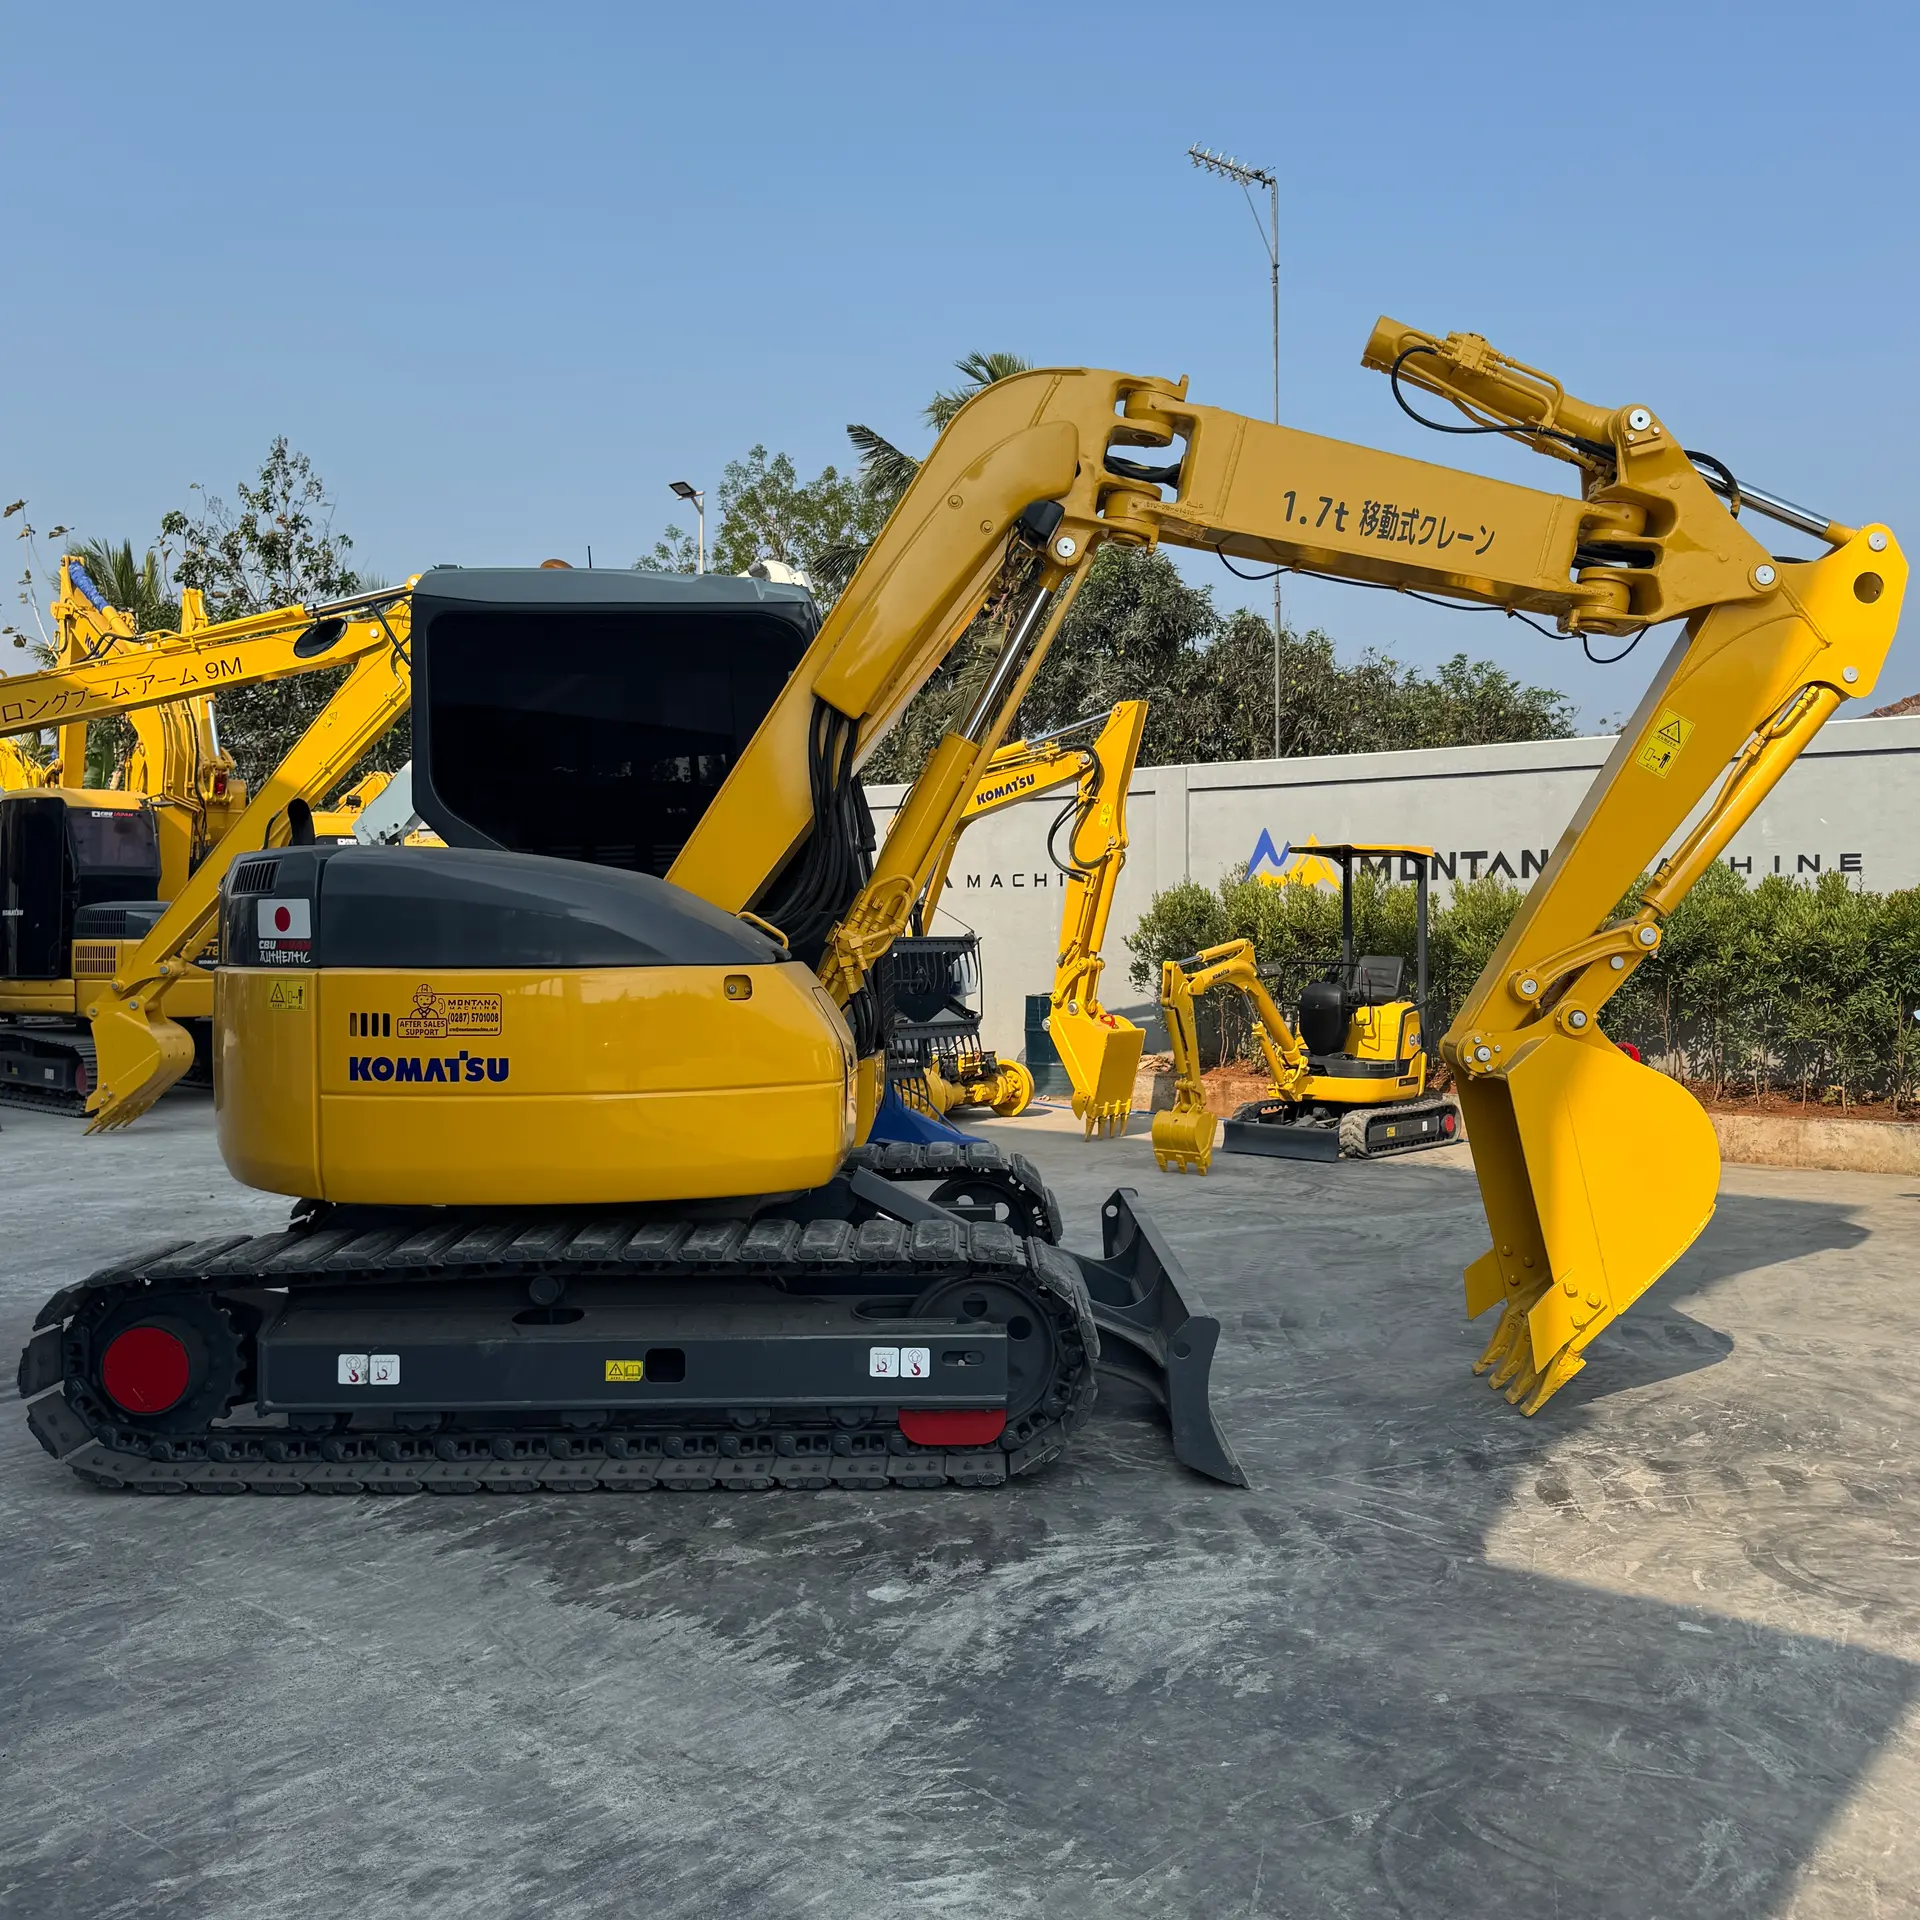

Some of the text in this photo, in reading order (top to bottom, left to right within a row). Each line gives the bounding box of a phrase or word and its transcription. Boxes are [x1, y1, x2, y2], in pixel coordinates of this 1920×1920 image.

[1283, 490, 1496, 556] 1.7t 移動式クレーン
[205, 656, 243, 680] 9M
[976, 773, 1035, 805] KOMATSU
[1360, 848, 1863, 881] MONTAN HINE
[967, 873, 1064, 889] MACHI
[258, 940, 276, 950] CBU
[260, 950, 311, 964] AUTHENTIC
[399, 1020, 446, 1028] AFTER SALES
[447, 1012, 470, 1025] (0287)
[405, 1028, 440, 1036] SUPPORT
[349, 1050, 510, 1083] KOMATSU
